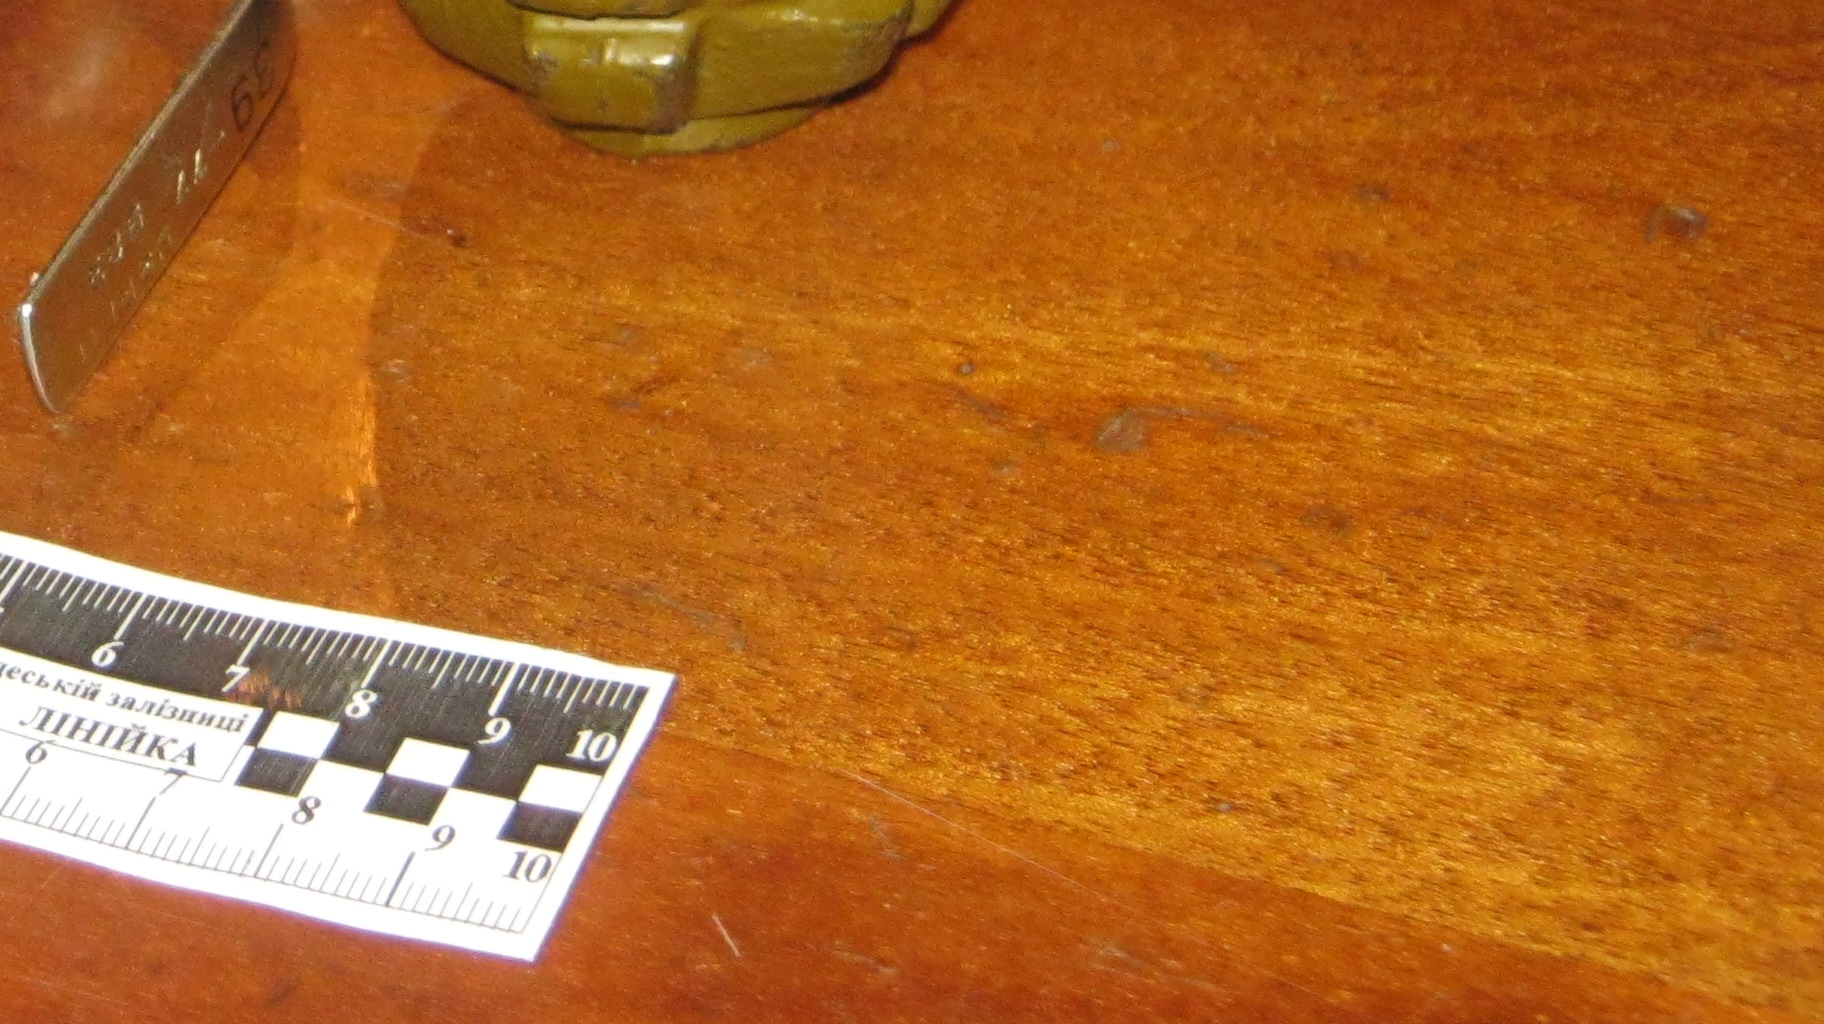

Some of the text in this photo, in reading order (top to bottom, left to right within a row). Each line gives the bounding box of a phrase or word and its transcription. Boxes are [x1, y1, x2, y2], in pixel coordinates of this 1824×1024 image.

[18, 705, 198, 767] ЛІНІЙКА
[91, 641, 125, 669] 6
[222, 664, 251, 693] 7
[345, 688, 378, 719] 8
[478, 716, 512, 746] 9
[566, 727, 617, 763] 10
[105, 690, 250, 733] залізниці
[25, 739, 56, 764] 6
[159, 767, 189, 796] 7
[292, 796, 321, 825] 8
[425, 824, 457, 852] 9
[502, 849, 553, 884] 10
